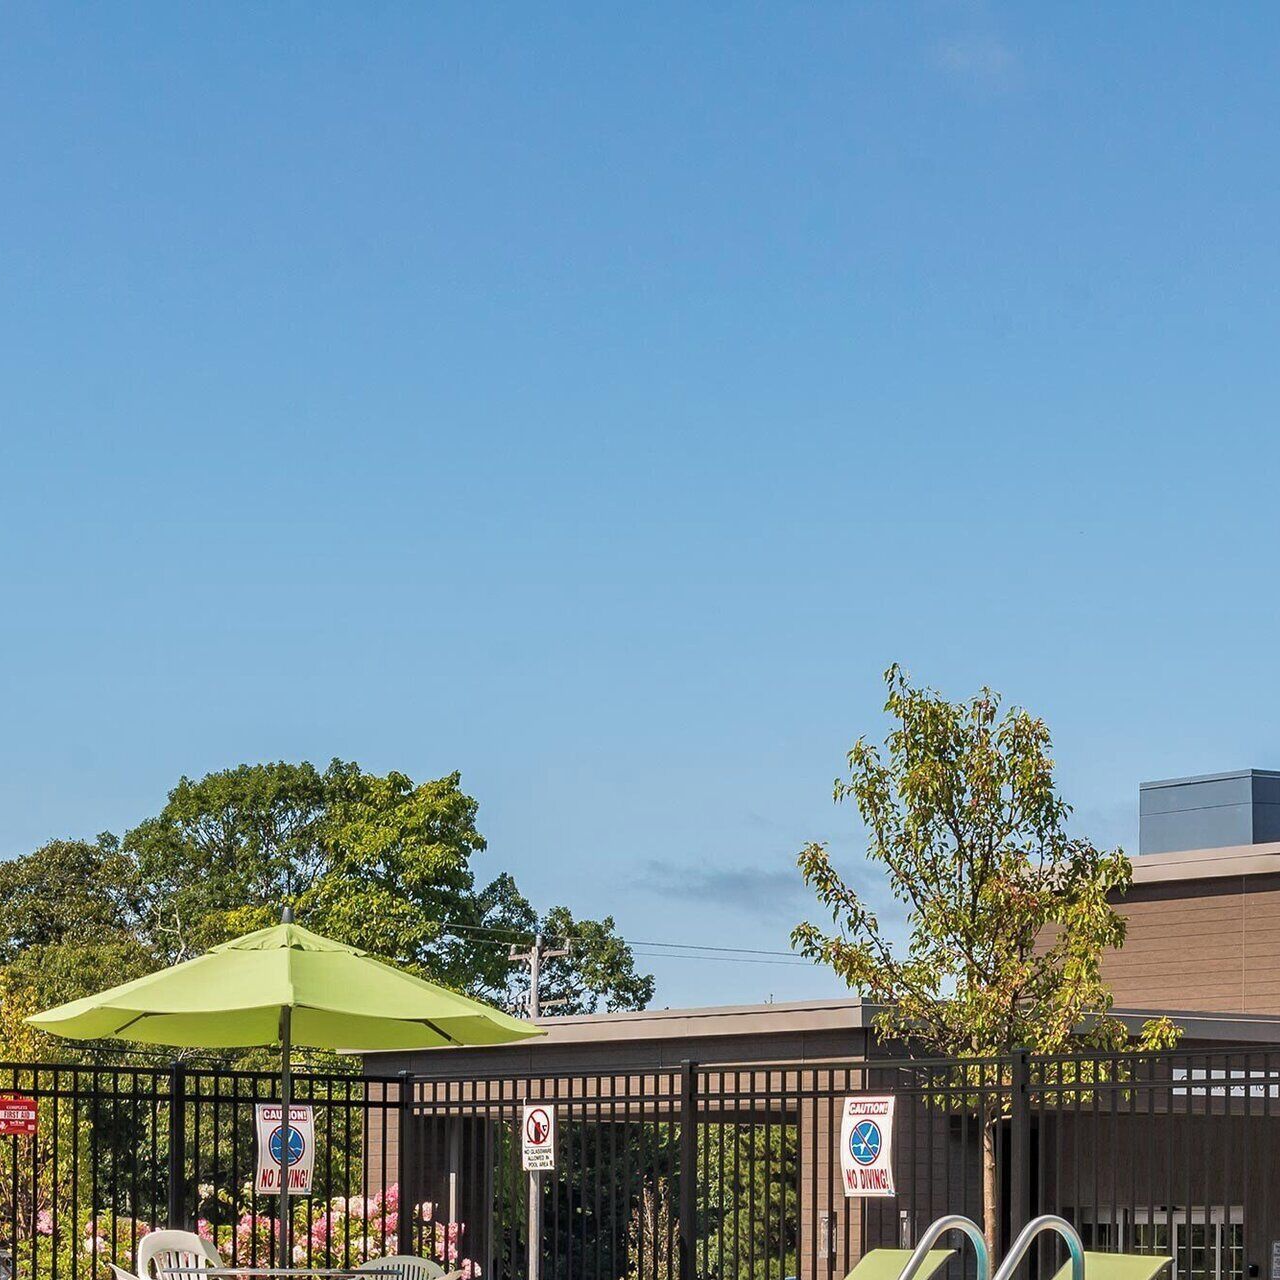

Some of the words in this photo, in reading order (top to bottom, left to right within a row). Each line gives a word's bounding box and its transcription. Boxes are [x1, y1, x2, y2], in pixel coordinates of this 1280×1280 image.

[3, 1110, 19, 1119] FIRST
[20, 1110, 31, 1119] AID
[263, 1109, 307, 1120] CAUION!
[849, 1102, 888, 1115] CAUTION!
[261, 1169, 274, 1187] NO
[277, 1169, 308, 1188] DVING!
[846, 1169, 858, 1189] NO
[860, 1169, 889, 1189] DIVING!
